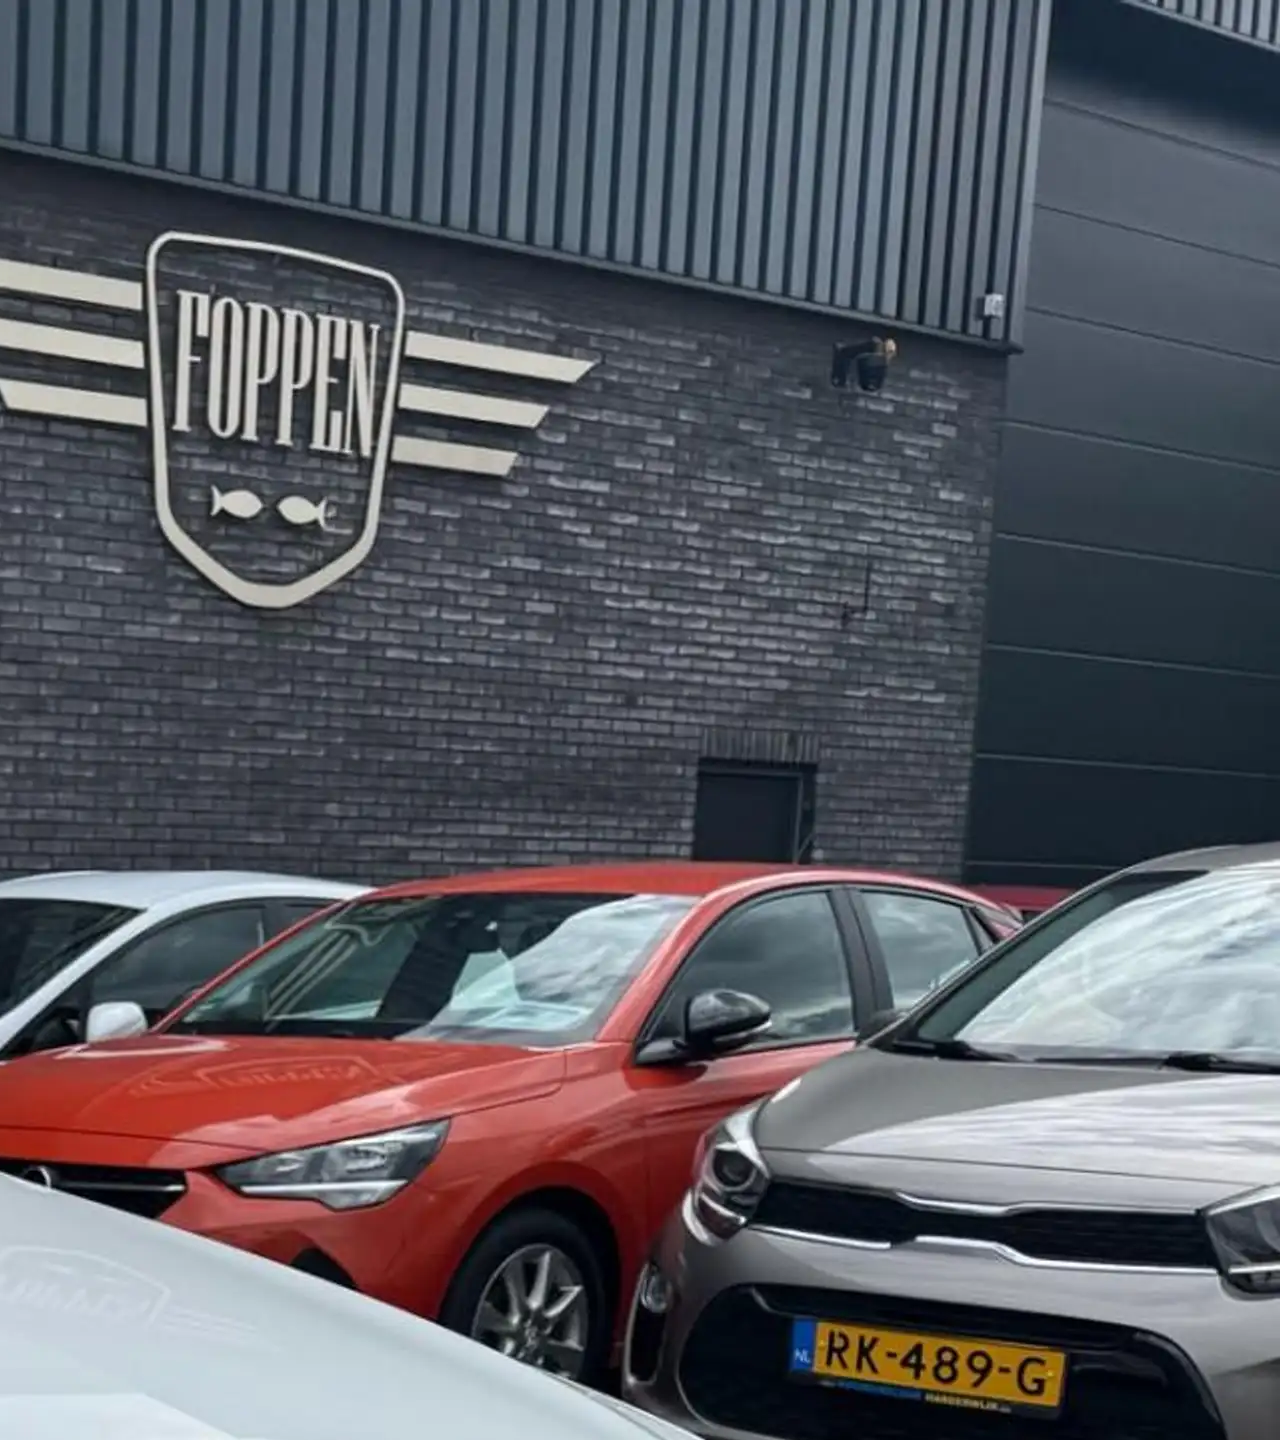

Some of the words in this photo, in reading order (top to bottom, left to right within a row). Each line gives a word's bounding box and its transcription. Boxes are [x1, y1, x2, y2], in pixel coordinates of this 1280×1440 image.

[172, 288, 380, 458] FOPPEN
[794, 1348, 811, 1364] NL
[825, 1330, 1046, 1397] RK-489-G
